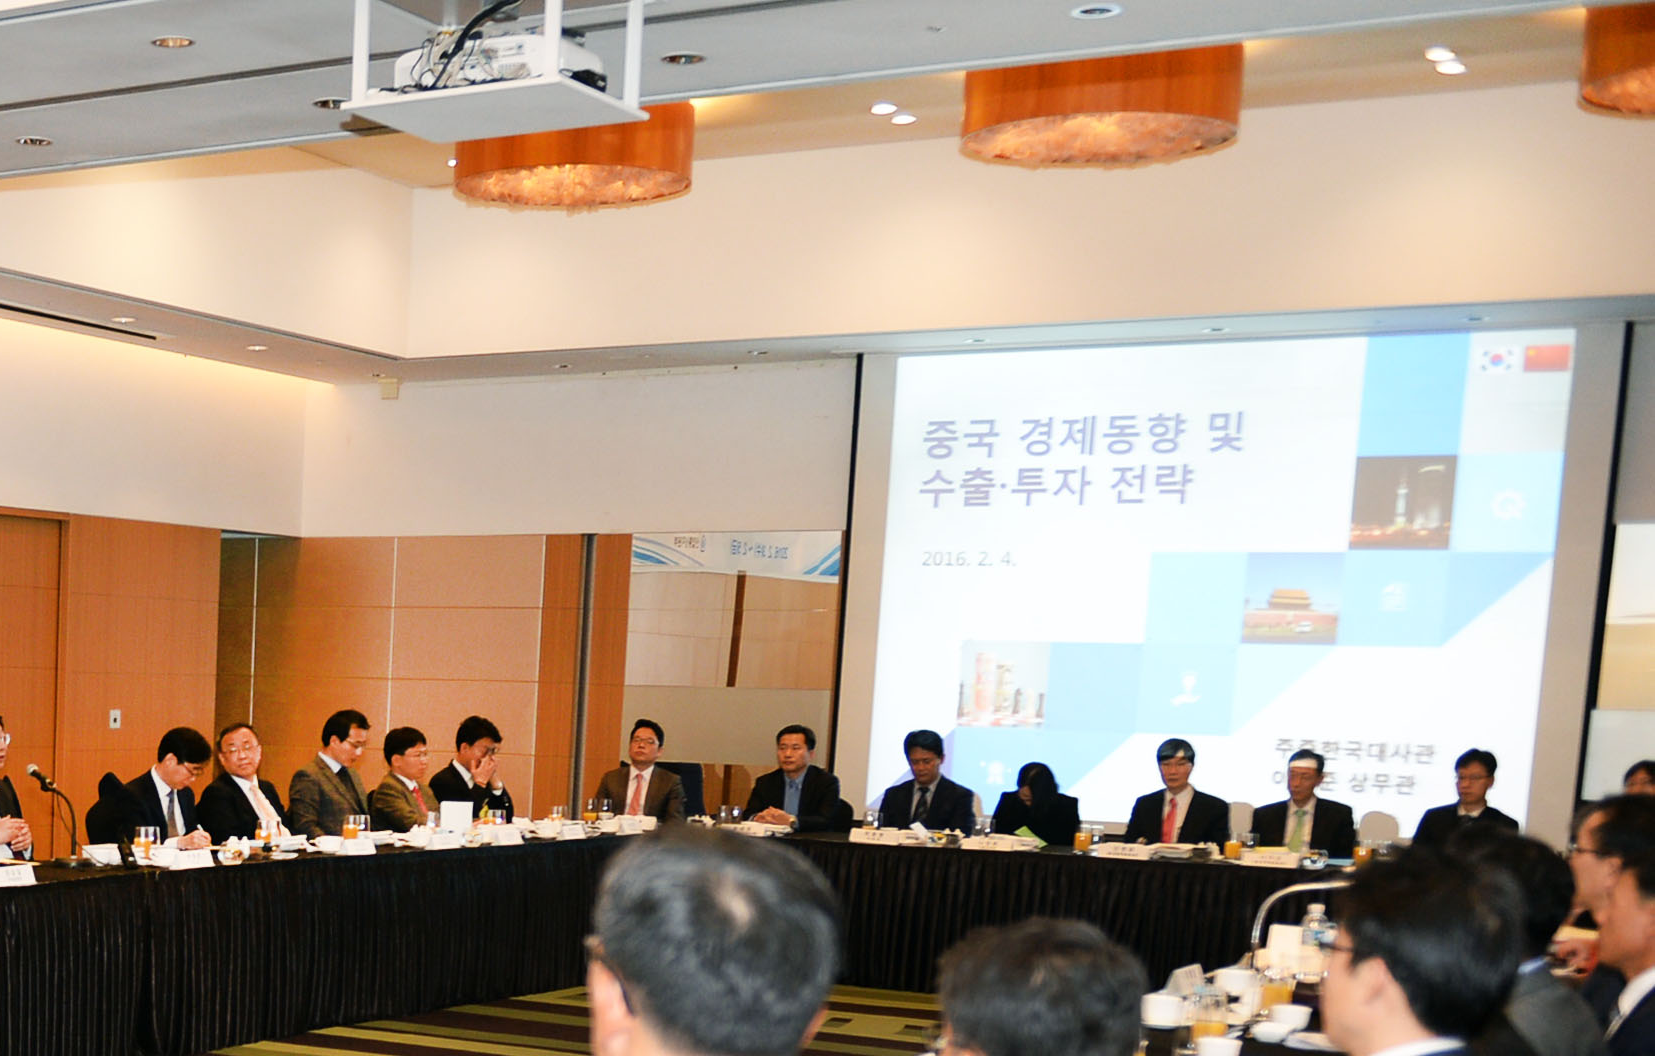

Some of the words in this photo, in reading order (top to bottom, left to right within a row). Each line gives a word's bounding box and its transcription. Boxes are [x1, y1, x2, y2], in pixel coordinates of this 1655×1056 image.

[922, 419, 1001, 460] 중국
[1019, 412, 1188, 457] 경제동향
[1208, 410, 1244, 453] 및
[918, 465, 1093, 509] 수출·투자
[1110, 463, 1195, 505] 전략
[1348, 773, 1416, 796] 상무관
